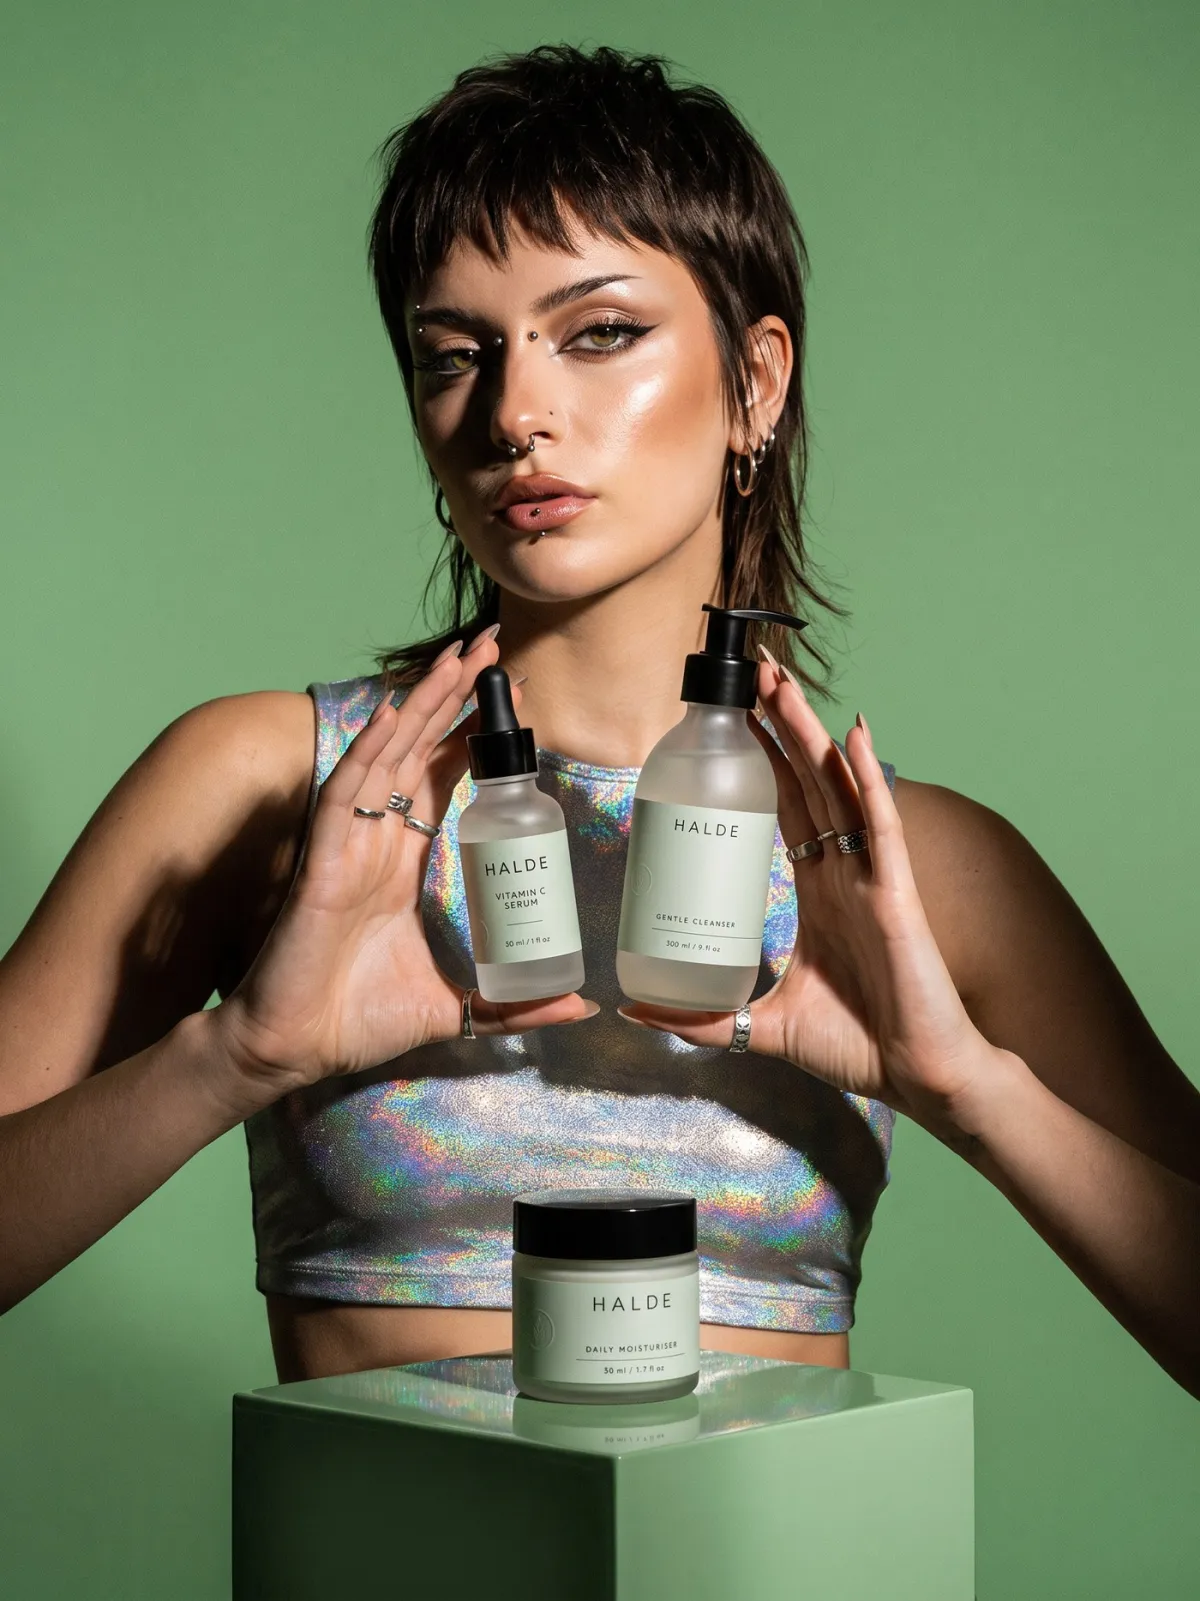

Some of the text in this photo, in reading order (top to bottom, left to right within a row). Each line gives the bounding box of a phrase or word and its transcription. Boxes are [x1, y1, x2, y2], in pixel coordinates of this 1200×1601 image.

[674, 818, 739, 838] HALDE
[485, 856, 548, 876] HALDE
[495, 887, 546, 901] VITAMIN C
[504, 898, 539, 910] SERUM
[655, 913, 736, 929] GENTLE CLEANSER
[666, 939, 679, 948] 300
[593, 1293, 671, 1312] HALDE
[585, 1341, 678, 1353] DAILY MOISTURISER
